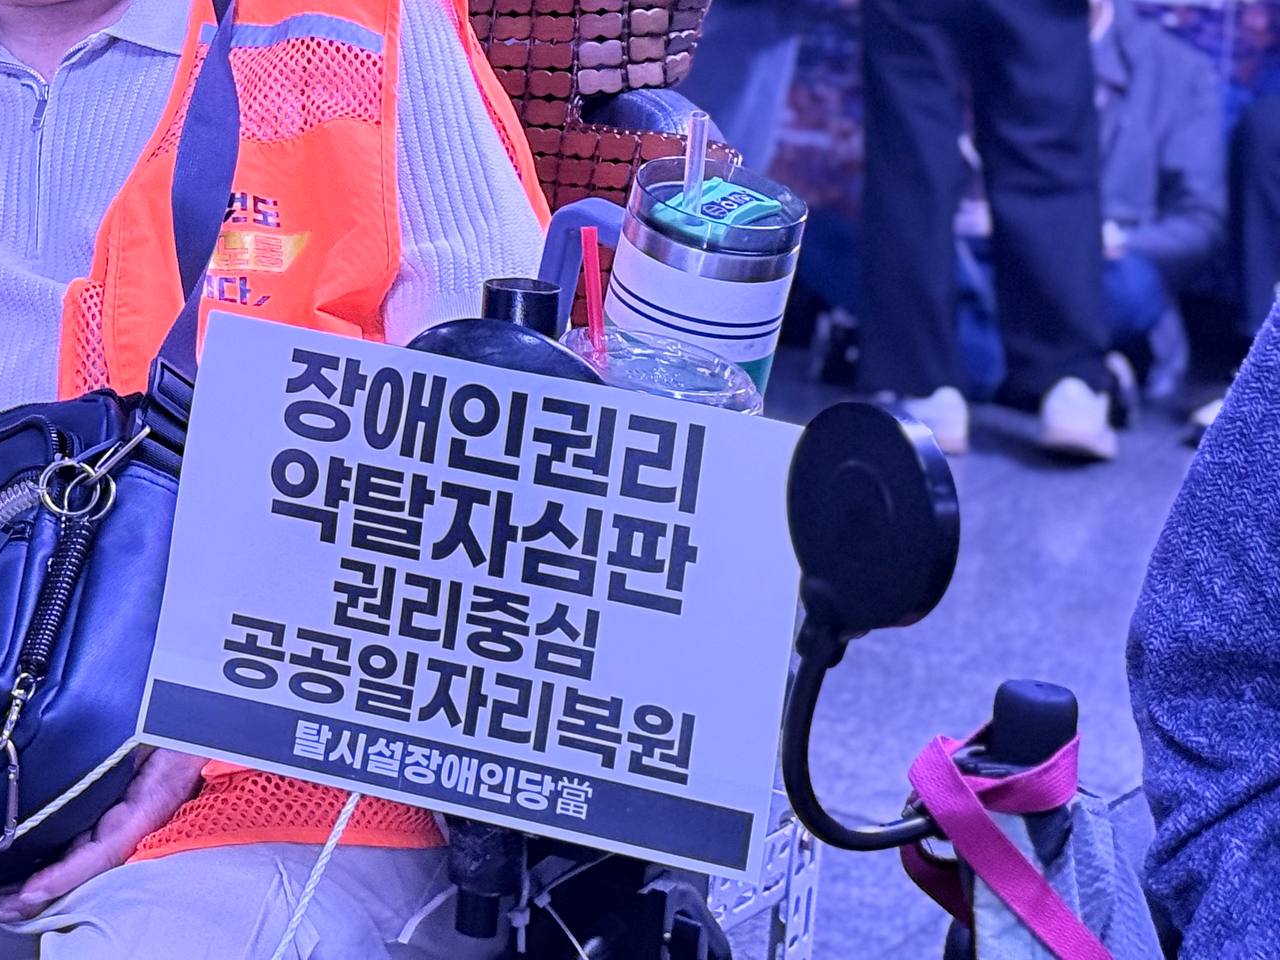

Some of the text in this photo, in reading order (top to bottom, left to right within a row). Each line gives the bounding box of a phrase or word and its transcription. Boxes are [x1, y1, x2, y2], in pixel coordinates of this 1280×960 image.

[284, 347, 708, 516] 장애인권리
[269, 446, 699, 617] 약탈자심판
[221, 612, 696, 787] 공공일자리복원
[331, 556, 601, 682] 권리중심
[292, 718, 594, 821] 탈시설장애인당當
